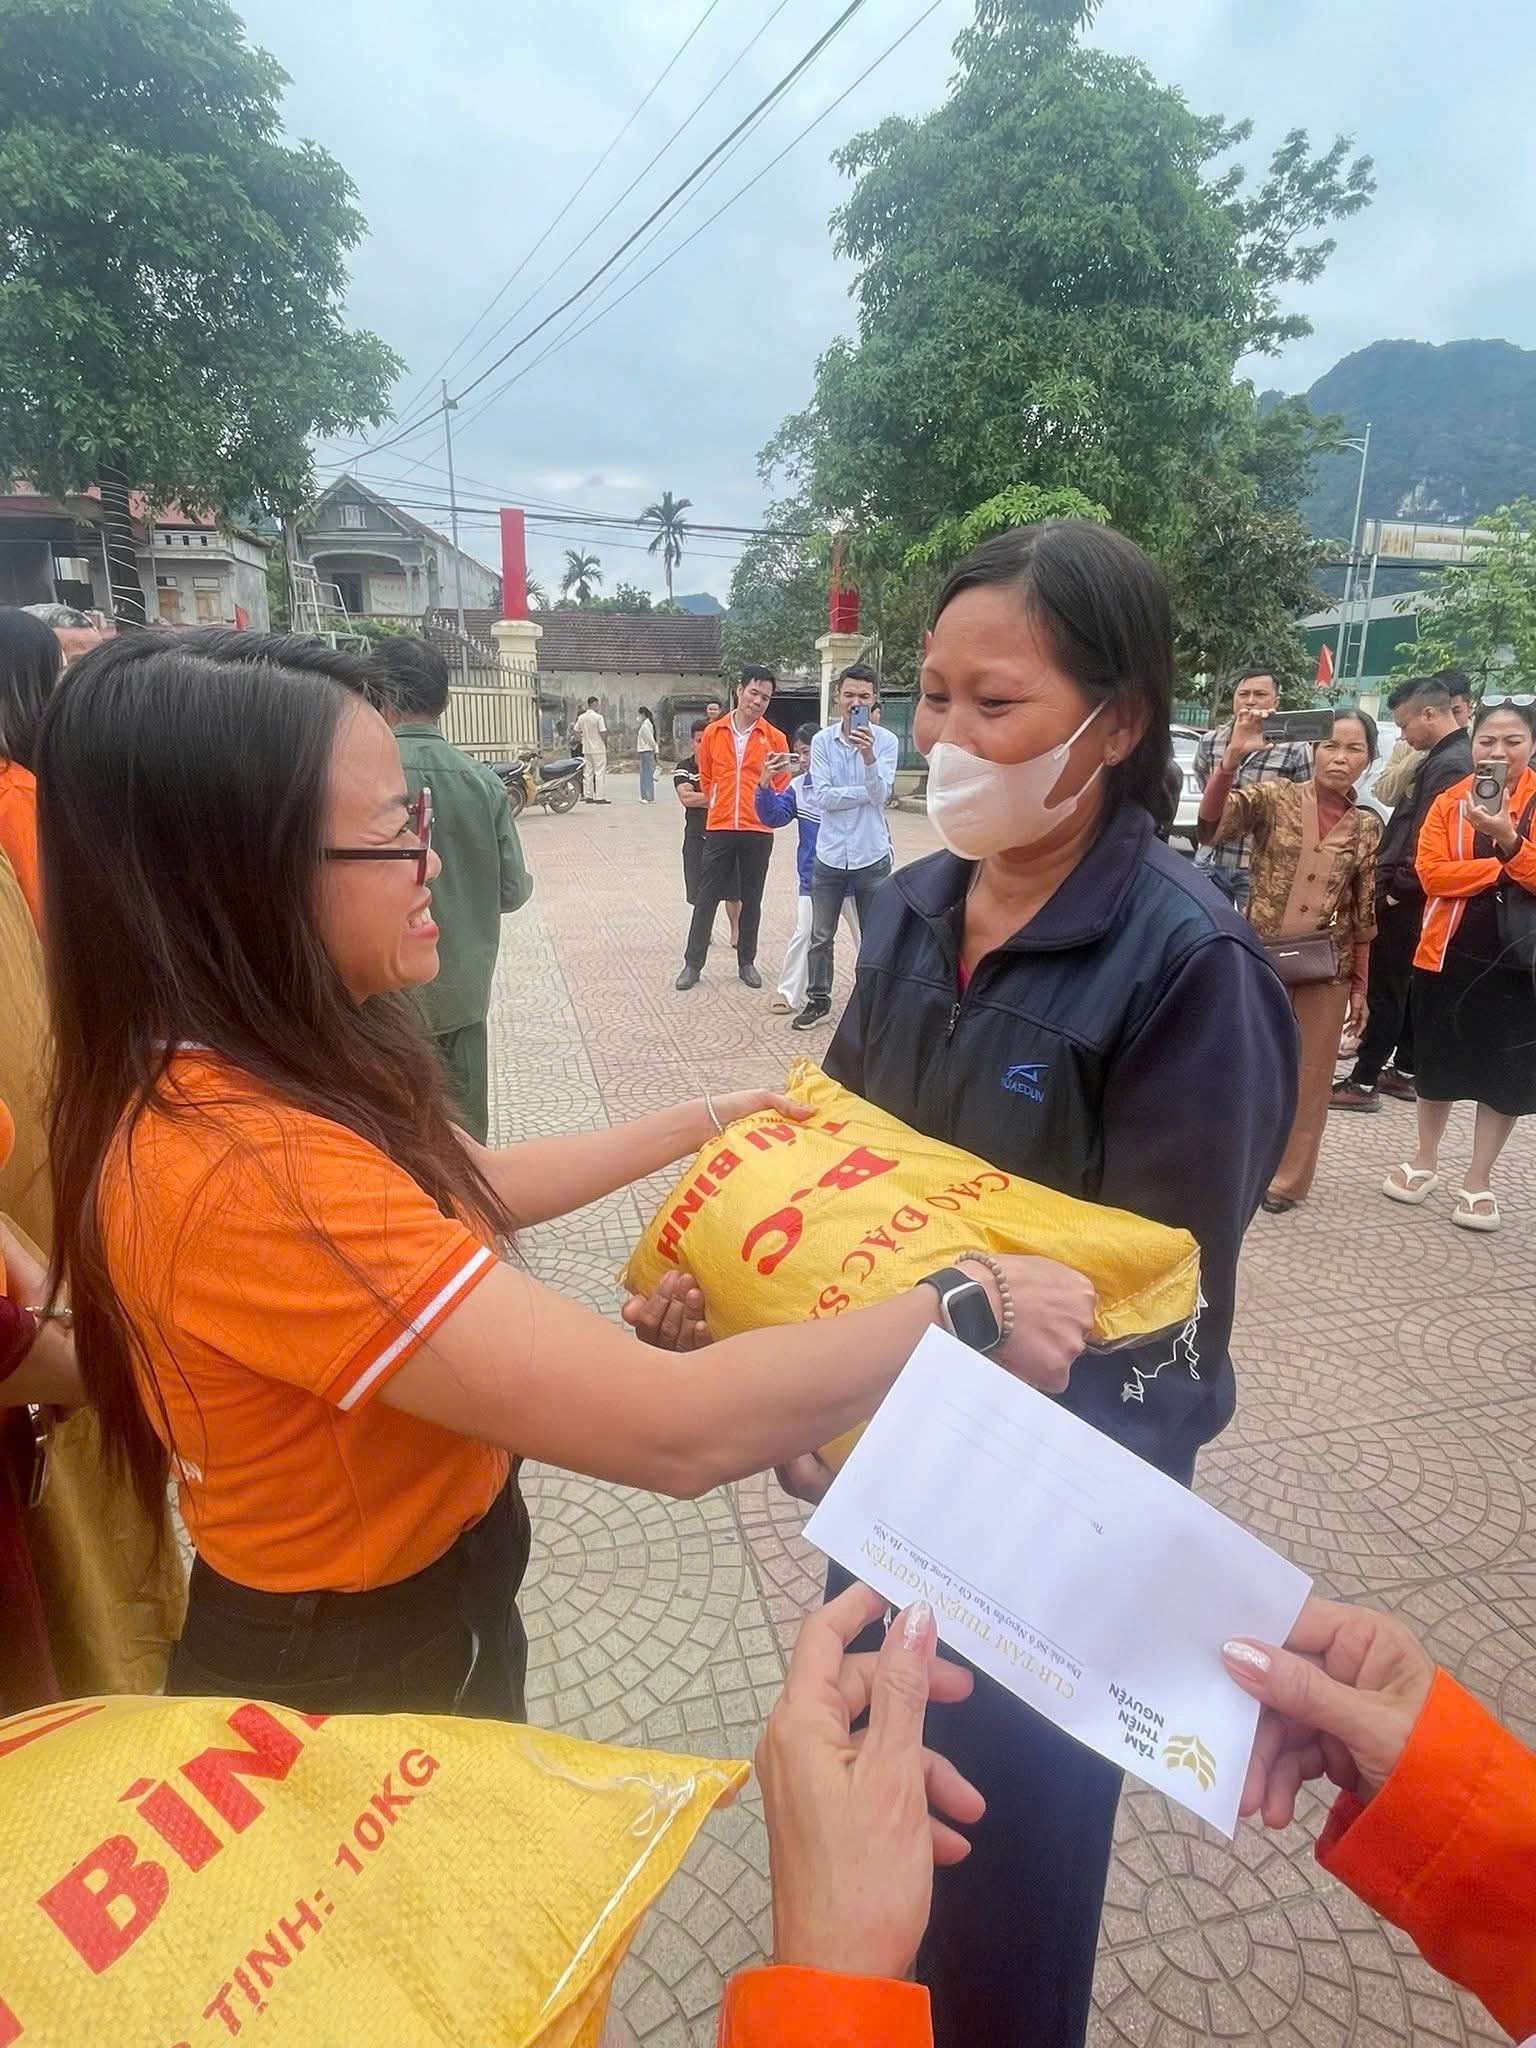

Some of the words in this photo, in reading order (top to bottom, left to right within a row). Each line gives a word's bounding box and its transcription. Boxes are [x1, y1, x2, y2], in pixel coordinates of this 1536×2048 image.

[744, 1120, 849, 1151] TÁI
[656, 1149, 744, 1265] BÌNH
[741, 1146, 900, 1276] B.C
[926, 1171, 1010, 1211] GẠO
[842, 1206, 929, 1282] ĐẶC
[860, 1539, 929, 1599] NGUYỆN
[935, 1592, 992, 1641] THIỆN
[996, 1634, 1034, 1672] TÂM
[1108, 1683, 1164, 1728] NGUYỆN
[1118, 1710, 1159, 1743] THIỆN
[1124, 1732, 1155, 1760] TÂM
[38, 1702, 331, 1974] BÌN
[202, 1888, 336, 2036] TỊNH:
[334, 1747, 441, 1876] 10KG
